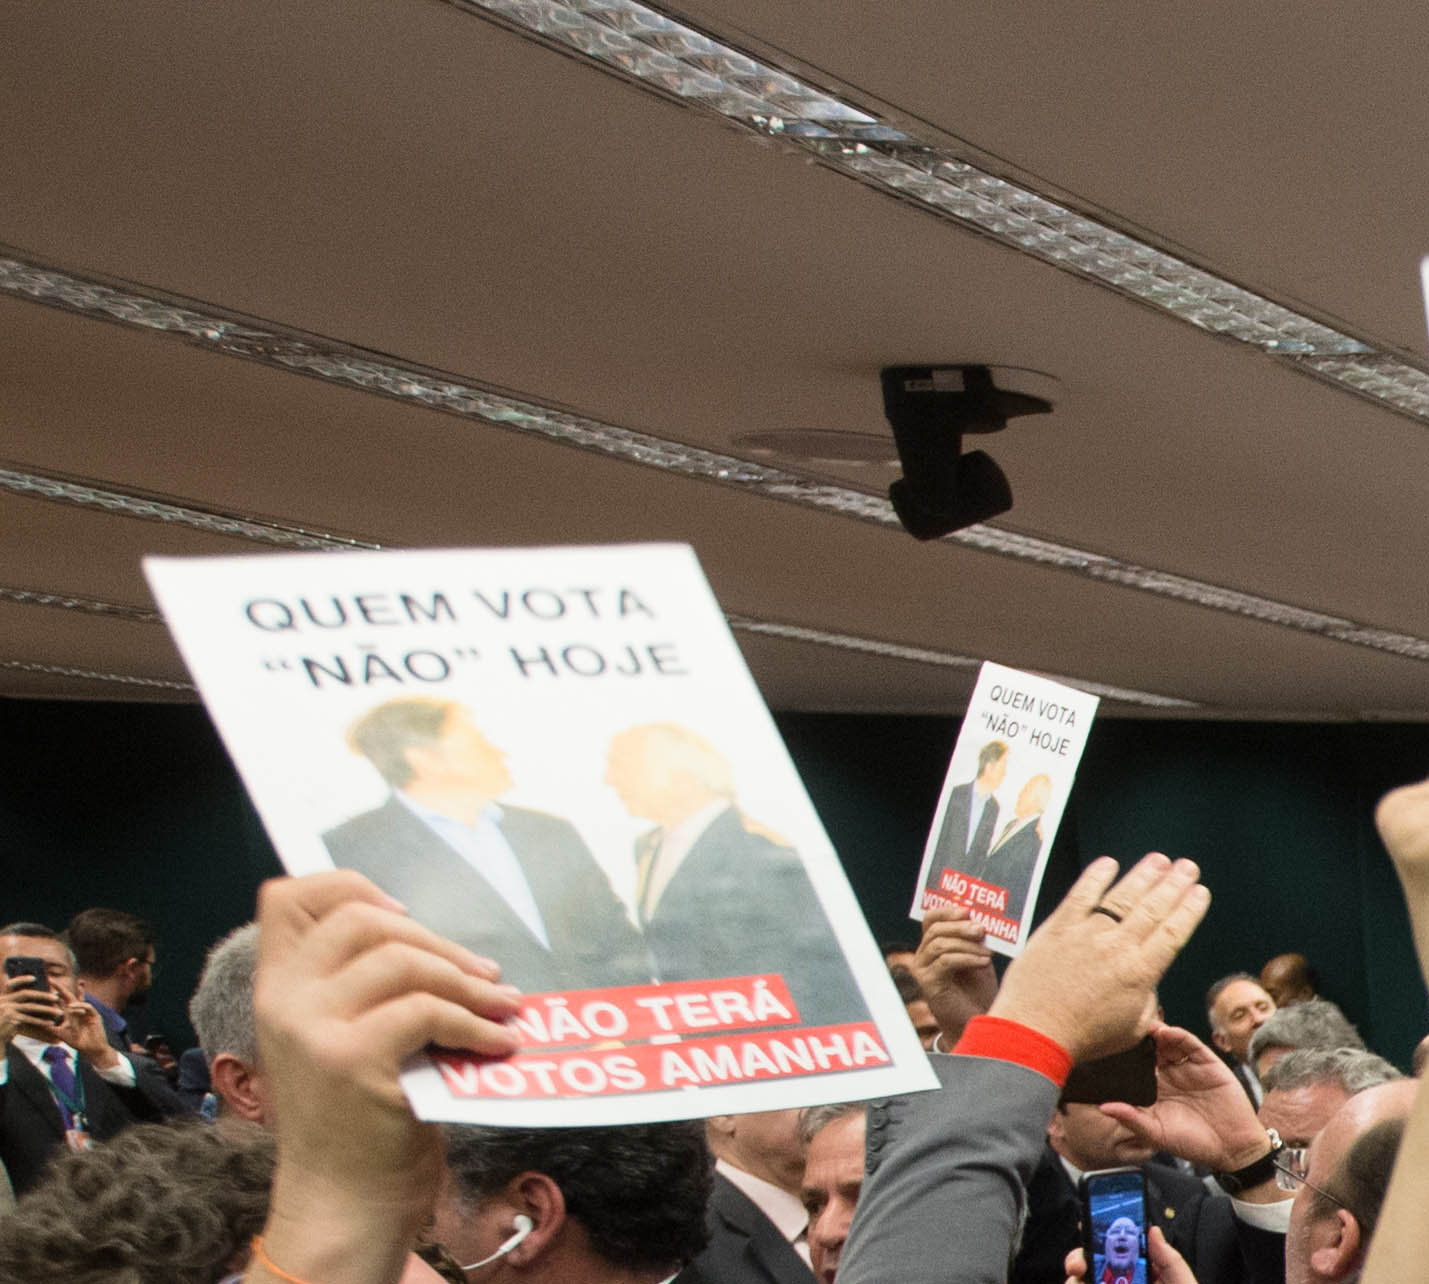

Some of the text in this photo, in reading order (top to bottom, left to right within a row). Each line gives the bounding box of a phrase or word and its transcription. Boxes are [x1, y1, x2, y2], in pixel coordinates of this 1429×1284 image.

[244, 587, 656, 633] QUEM VOTA
[508, 643, 690, 679] HOJE
[990, 685, 1077, 728] QUEM VOTA
[1029, 728, 1071, 756] HOJE
[941, 873, 1007, 911] NÃO TERÁ
[969, 909, 1018, 941] MANHA
[636, 979, 793, 1032] TERÁ
[438, 1030, 891, 1095] VOTOS AMANHA
